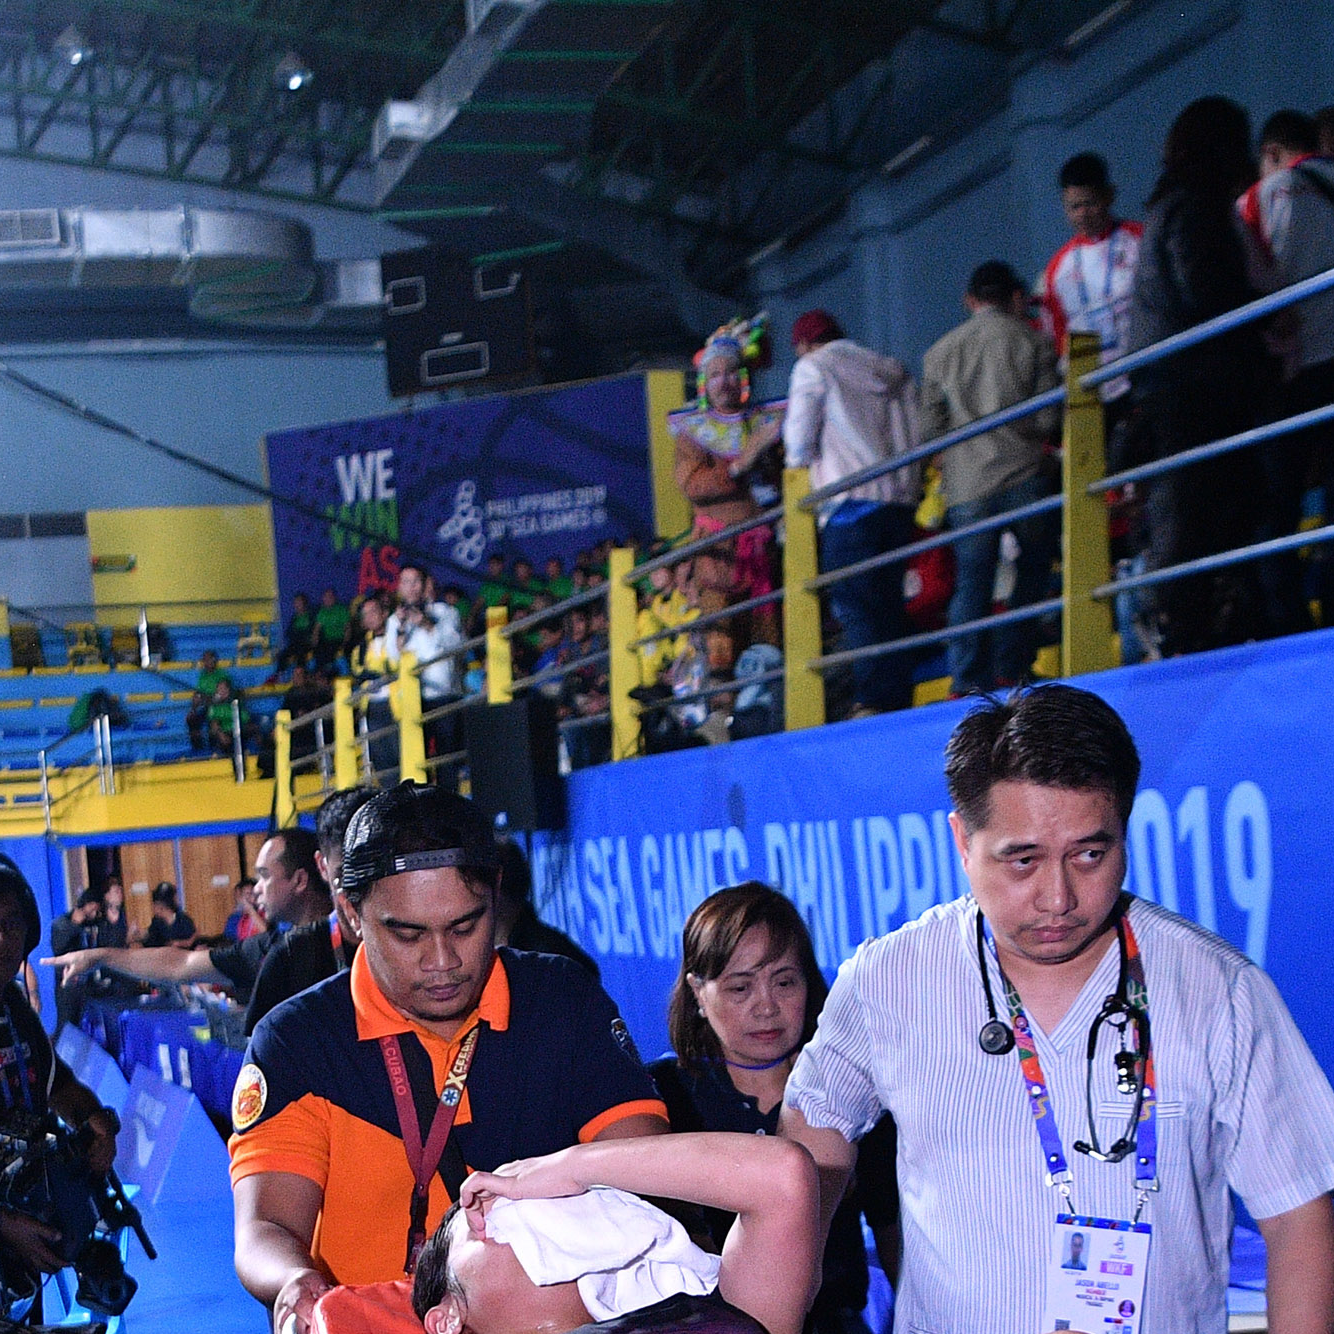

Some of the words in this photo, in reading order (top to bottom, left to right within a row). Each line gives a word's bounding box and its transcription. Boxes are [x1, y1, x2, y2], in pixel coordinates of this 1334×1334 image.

[335, 448, 397, 504] WE
[358, 545, 400, 594] AS
[584, 834, 645, 957] SEA
[764, 809, 972, 968] PHILIPPI
[1123, 780, 1273, 969] 019
[385, 1047, 406, 1096] CUBAO
